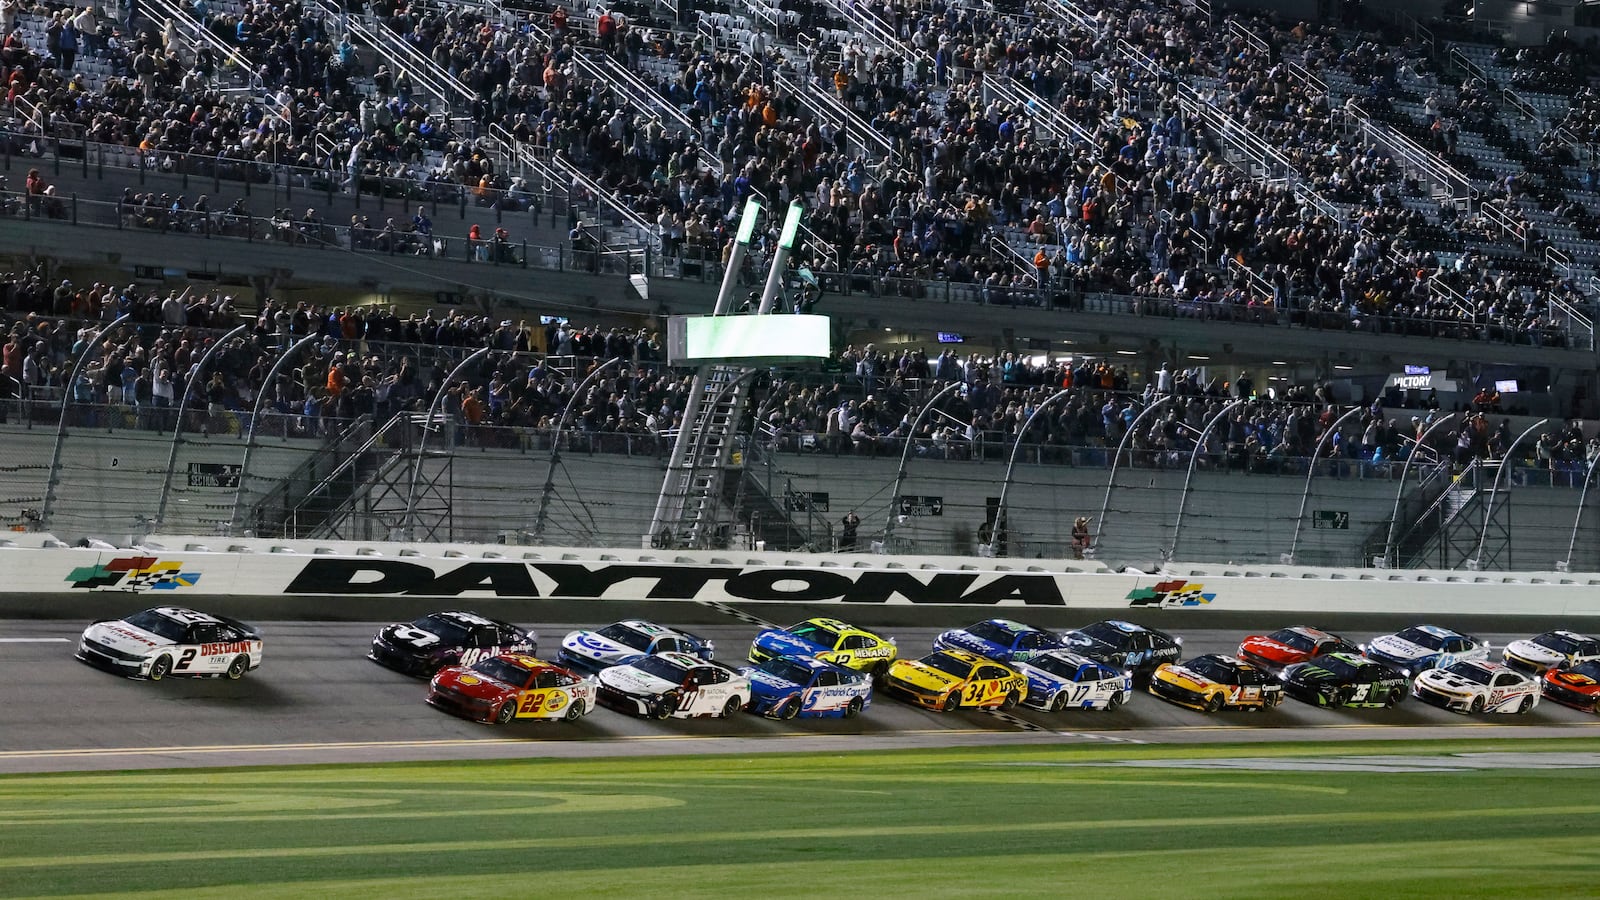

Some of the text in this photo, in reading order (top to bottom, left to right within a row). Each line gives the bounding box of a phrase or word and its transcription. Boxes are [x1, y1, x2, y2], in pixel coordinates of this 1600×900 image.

[1394, 376, 1432, 388] VICTORY
[283, 559, 1067, 606] DAYTONA
[201, 640, 251, 657] DISCOUNT
[854, 648, 891, 659] MENARDS
[1152, 647, 1179, 658] CARVANA
[174, 648, 197, 671] 2
[210, 656, 227, 664] TIRE
[460, 647, 481, 668] 48
[571, 686, 590, 698] Shell
[965, 684, 985, 702] 34
[1071, 685, 1090, 702] 17
[1096, 680, 1125, 692] FASTENAL
[519, 694, 546, 713] 22
[677, 691, 698, 711] 11
[804, 690, 822, 711] 5
[1228, 686, 1241, 704] 4
